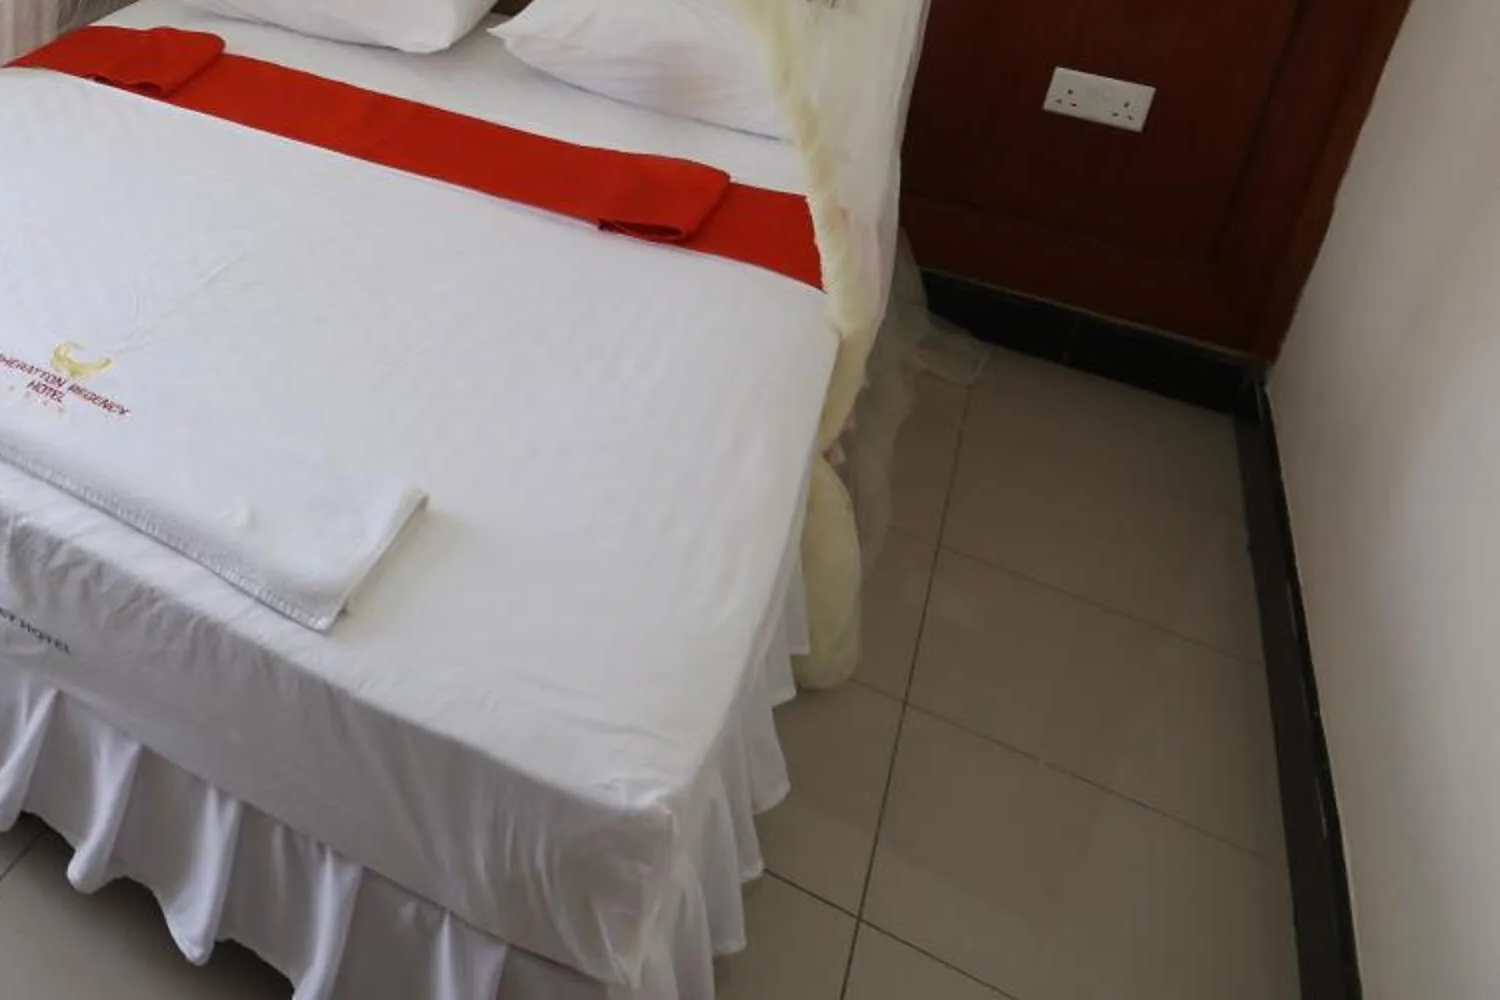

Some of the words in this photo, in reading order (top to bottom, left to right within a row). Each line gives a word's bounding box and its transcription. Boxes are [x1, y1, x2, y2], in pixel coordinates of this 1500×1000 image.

[26, 380, 65, 403] HOTEL
[67, 383, 131, 416] REGENCY
[19, 618, 71, 656] HOTEL
